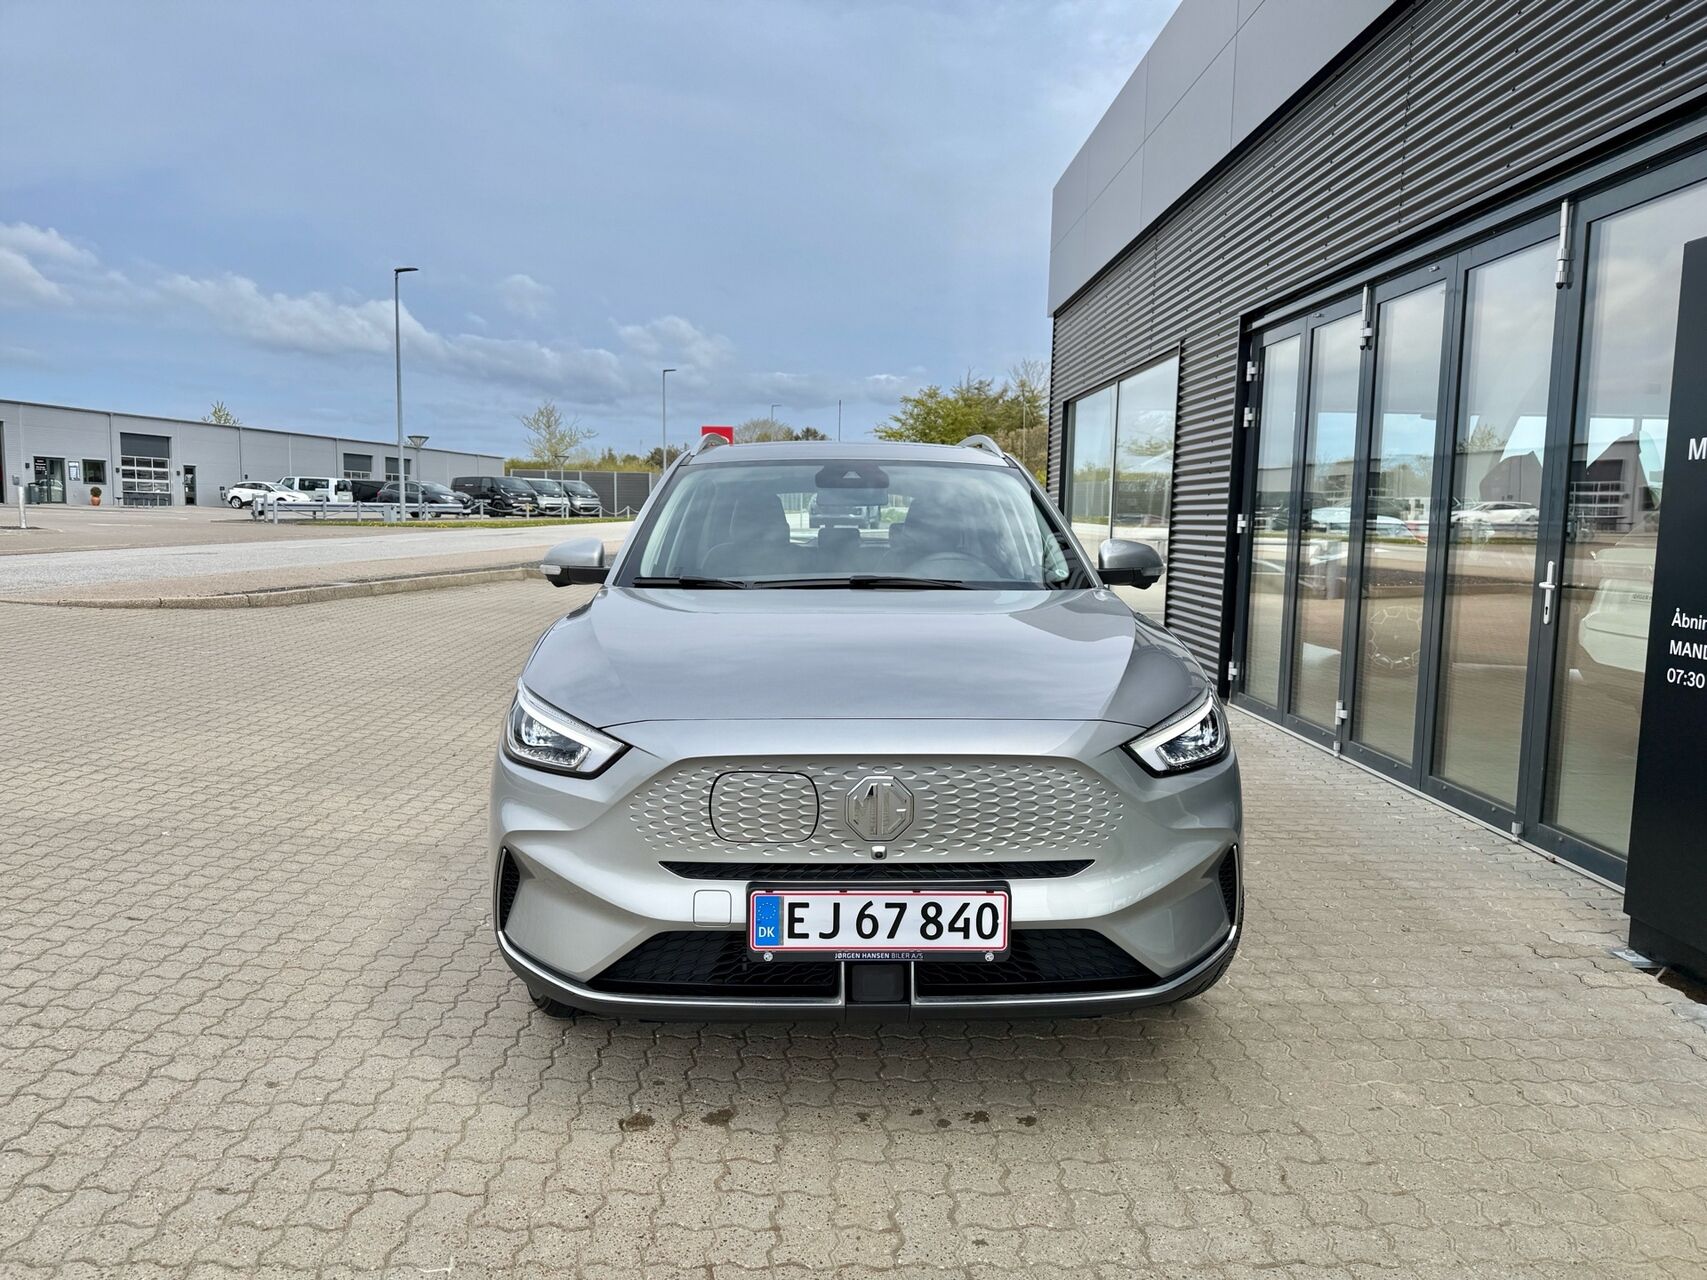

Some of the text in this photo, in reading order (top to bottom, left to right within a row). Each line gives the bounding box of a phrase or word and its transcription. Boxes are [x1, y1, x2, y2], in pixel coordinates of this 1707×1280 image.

[1666, 667, 1706, 689] 07:30
[787, 900, 1000, 941] EJ 67 840
[758, 926, 776, 939] DK
